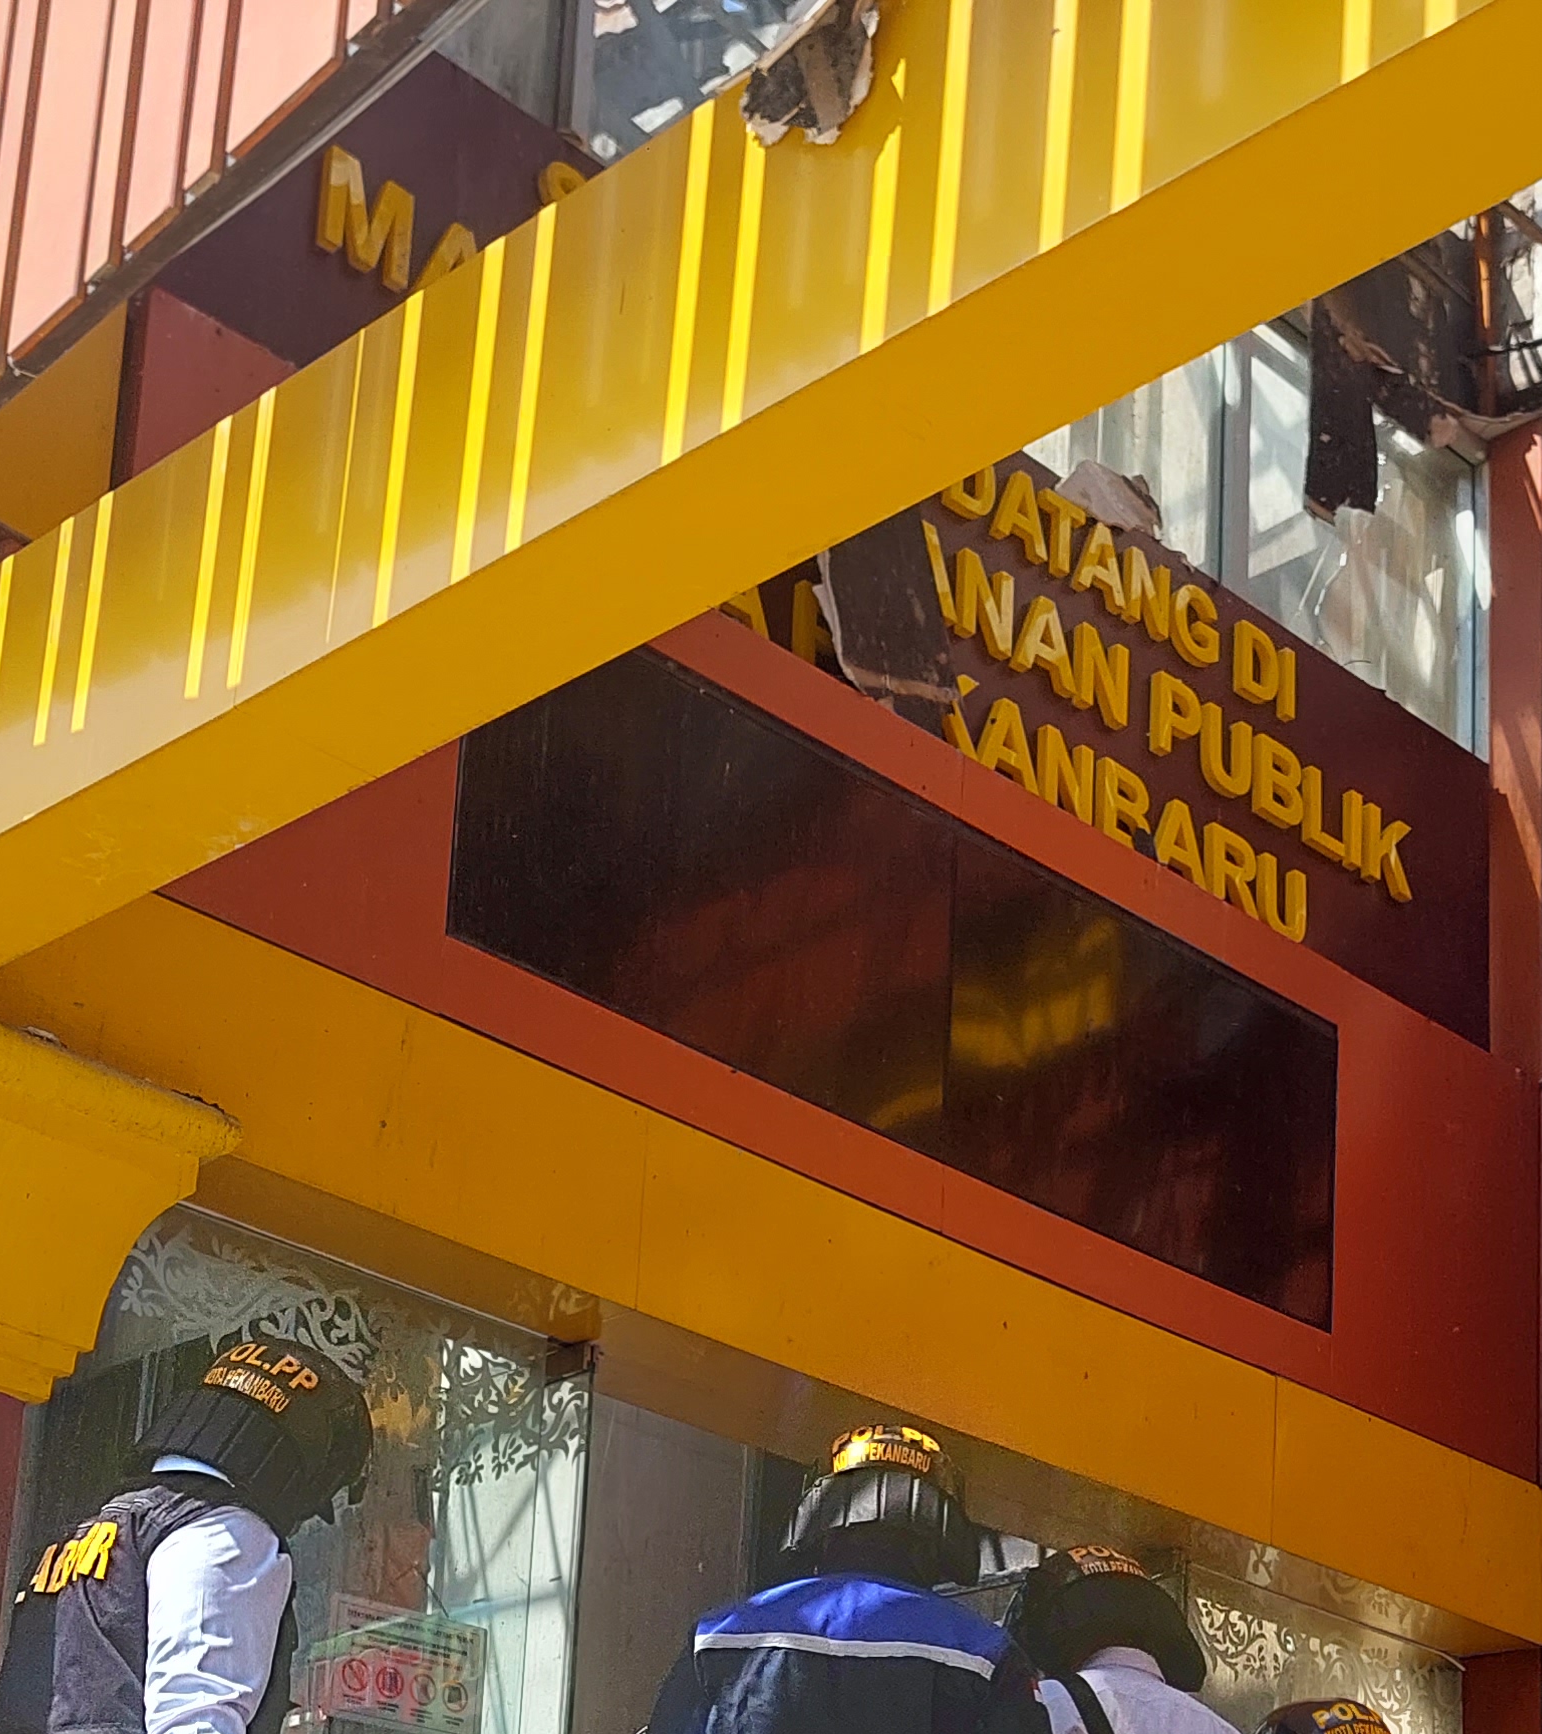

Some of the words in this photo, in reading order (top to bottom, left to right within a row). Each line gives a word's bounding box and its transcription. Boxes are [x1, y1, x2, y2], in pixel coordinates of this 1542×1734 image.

[941, 466, 1219, 668] DATANG
[1233, 619, 1295, 721] DI
[1149, 670, 1412, 902] PUBLIK
[213, 1343, 319, 1390] OL.PP
[863, 1443, 932, 1473] PEKANBARU
